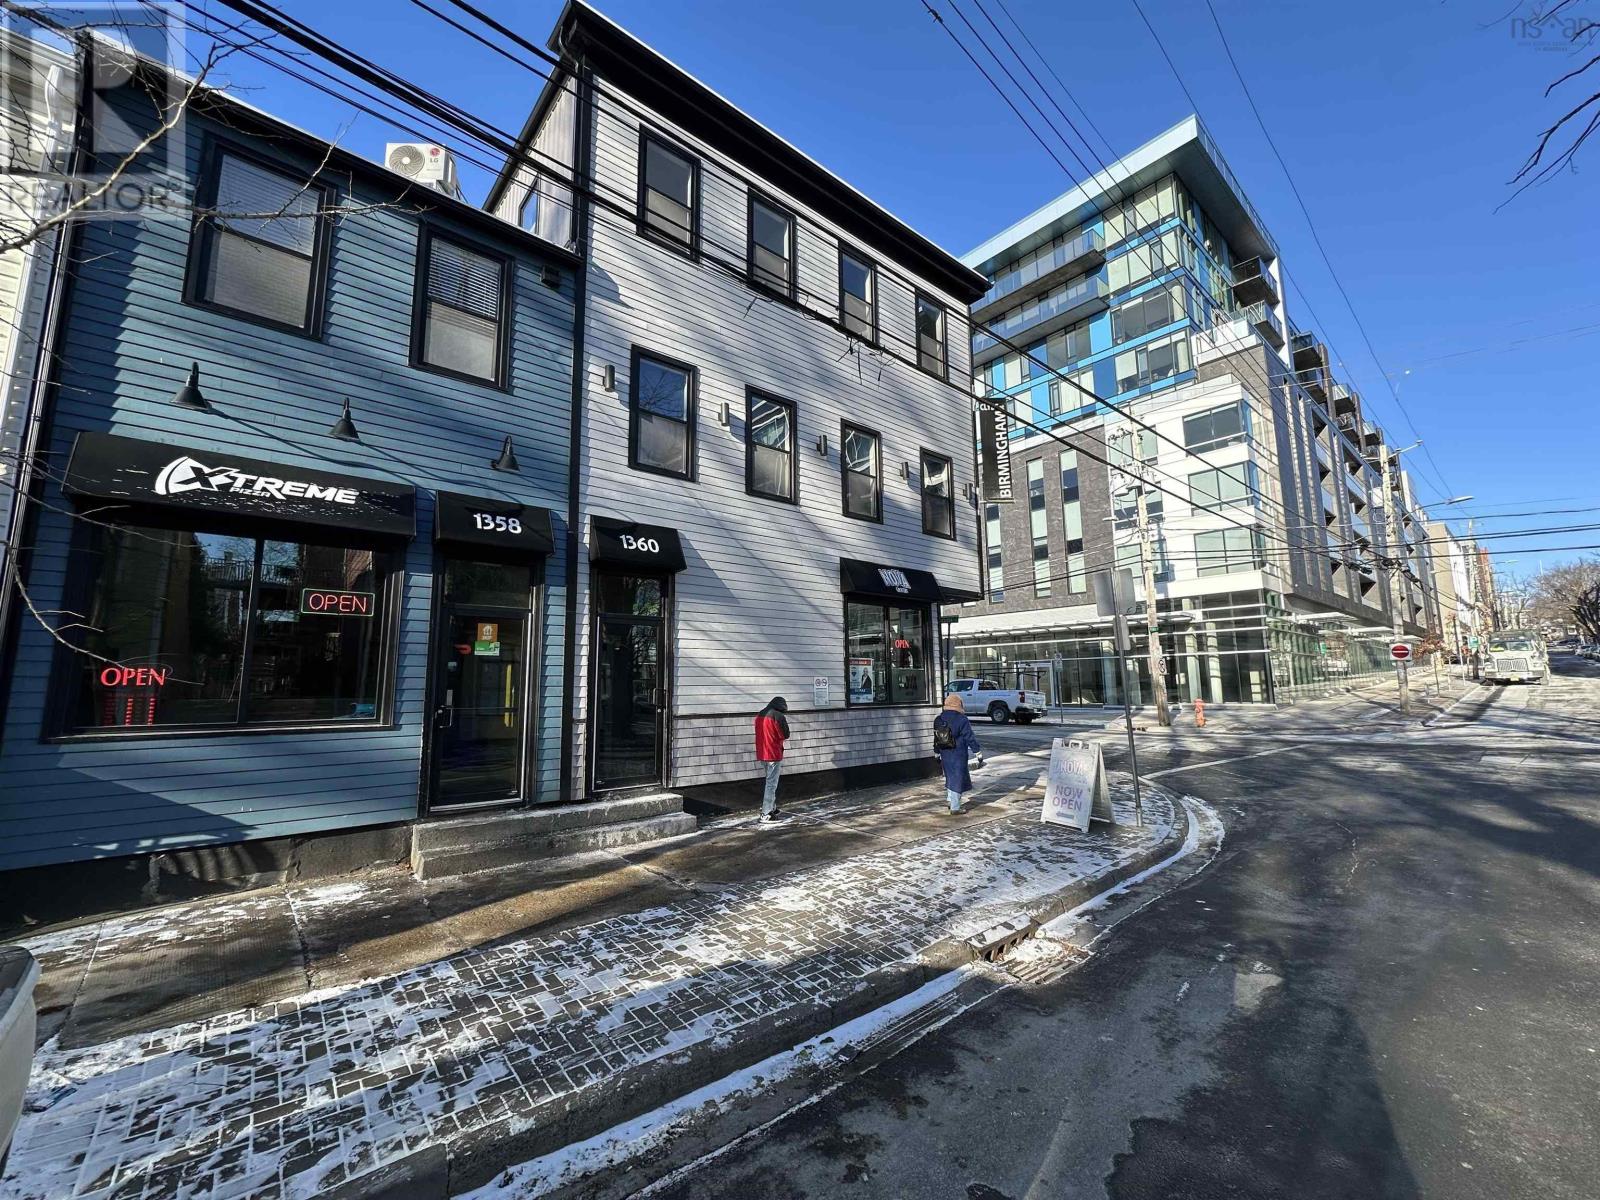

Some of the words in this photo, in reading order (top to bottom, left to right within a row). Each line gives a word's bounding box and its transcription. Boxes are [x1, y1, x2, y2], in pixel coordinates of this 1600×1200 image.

[995, 410, 1012, 498] BIRMINGHAM
[166, 460, 359, 504] XTREME
[229, 487, 271, 497] PIZZA
[473, 513, 522, 534] 1358
[620, 534, 660, 553] 1360
[309, 593, 366, 612] OPEN
[895, 640, 909, 648] OPEN
[101, 668, 165, 686] OPEN
[1055, 785, 1083, 798] NOW
[1052, 796, 1082, 811] OPEN
